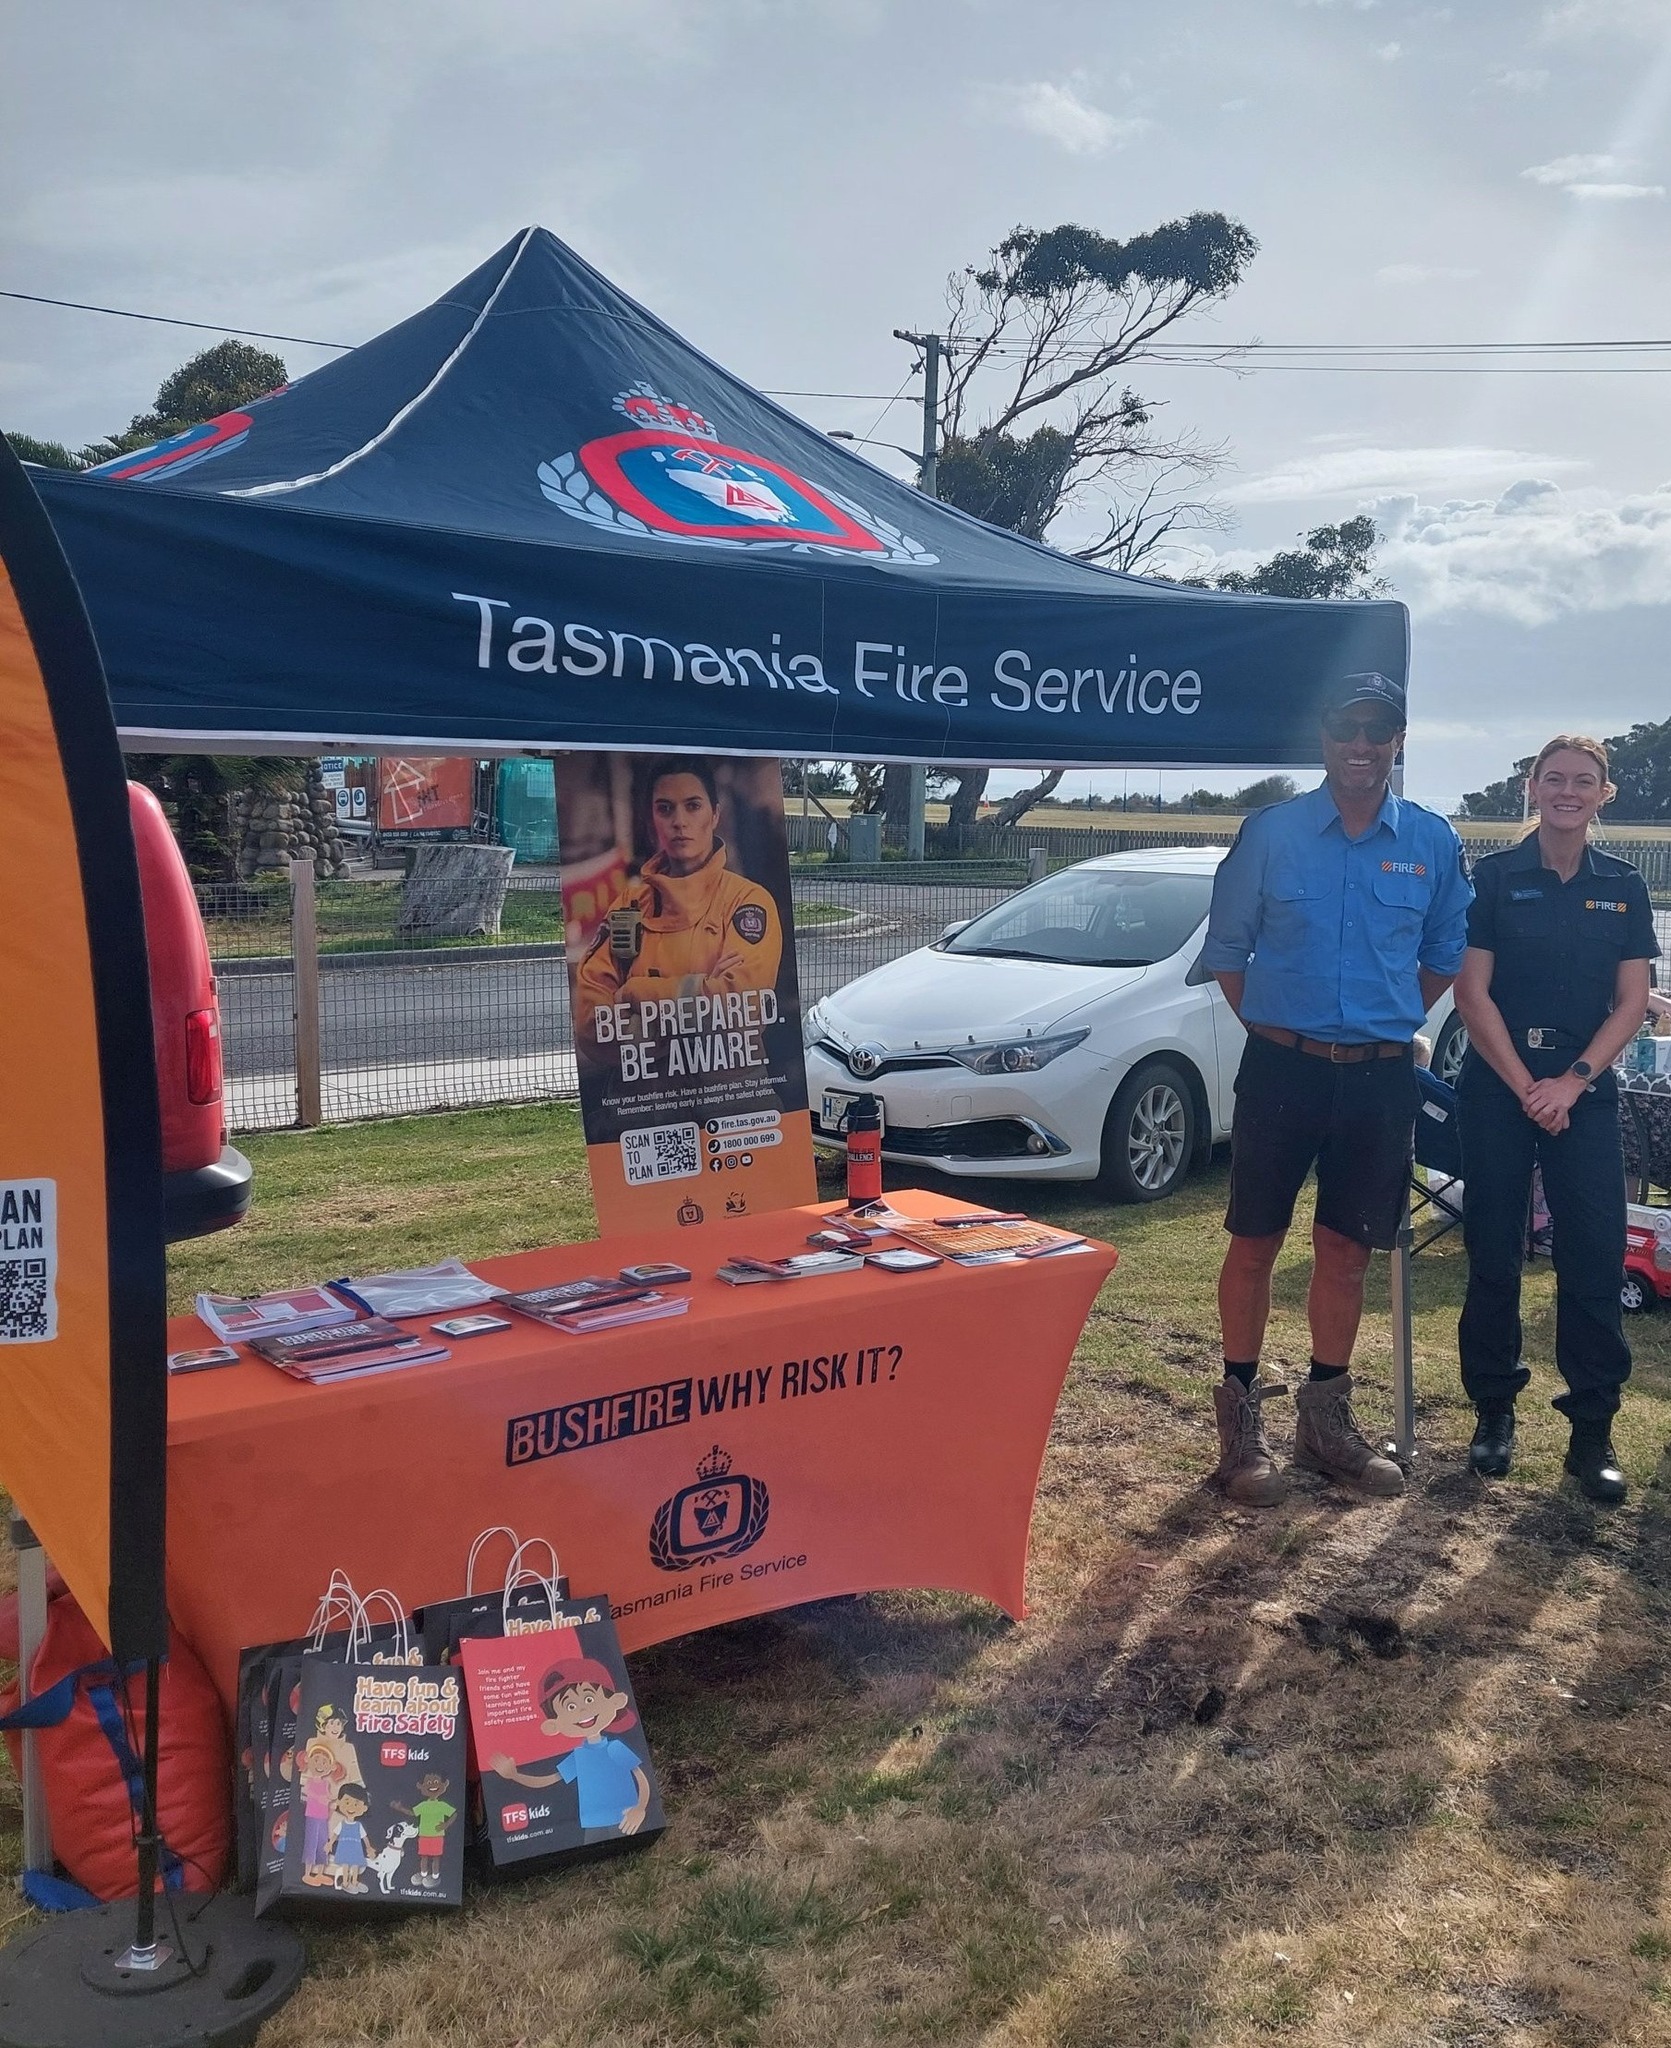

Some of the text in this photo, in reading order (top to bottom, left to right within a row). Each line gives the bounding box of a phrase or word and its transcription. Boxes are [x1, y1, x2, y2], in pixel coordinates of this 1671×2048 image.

[451, 592, 1202, 715] Tasmania Fire Service
[1392, 862, 1416, 874] FIRE
[1595, 901, 1618, 912] FIRE
[594, 988, 785, 1043] BE PREPARED.
[620, 1030, 769, 1083] BE AWARE.
[601, 1097, 620, 1106] Know
[621, 1095, 636, 1105] your
[637, 1091, 664, 1102] bushfire
[665, 1089, 679, 1098] risk.
[680, 1087, 697, 1096] Have
[704, 1083, 728, 1093] bushfire
[729, 1081, 743, 1091] plan.
[744, 1079, 759, 1088] Stay
[760, 1074, 787, 1085] informed.
[655, 1101, 677, 1110] leaving
[679, 1098, 695, 1107] early
[696, 1097, 703, 1105] is
[703, 1095, 724, 1104] always
[725, 1093, 735, 1101] the
[736, 1090, 754, 1100] safest
[755, 1087, 776, 1098] option.
[721, 1114, 776, 1130] fire.tas.gov.au
[624, 1133, 650, 1150] SCAN
[723, 1133, 775, 1149] 1800 000 699
[627, 1151, 640, 1164] TO
[628, 1164, 654, 1181] PLAN
[510, 1344, 903, 1463] BUSHFIRE WHY RISK IT?
[700, 1572, 734, 1592] Fire
[740, 1554, 807, 1581] Service
[507, 1617, 552, 1637] Have
[498, 1674, 520, 1683] fighter
[357, 1676, 459, 1700] Have fun &
[353, 1693, 460, 1717] learn about
[485, 1701, 511, 1709] learning
[487, 1708, 518, 1717] important
[356, 1712, 455, 1740] Fire Safety
[484, 1713, 539, 1726] safety messages.
[382, 1748, 430, 1761] TFS kids
[503, 1804, 550, 1824] TFS kids
[506, 1828, 554, 1843] tfskids.com.au
[400, 1888, 447, 1898] tfskids.com.au
